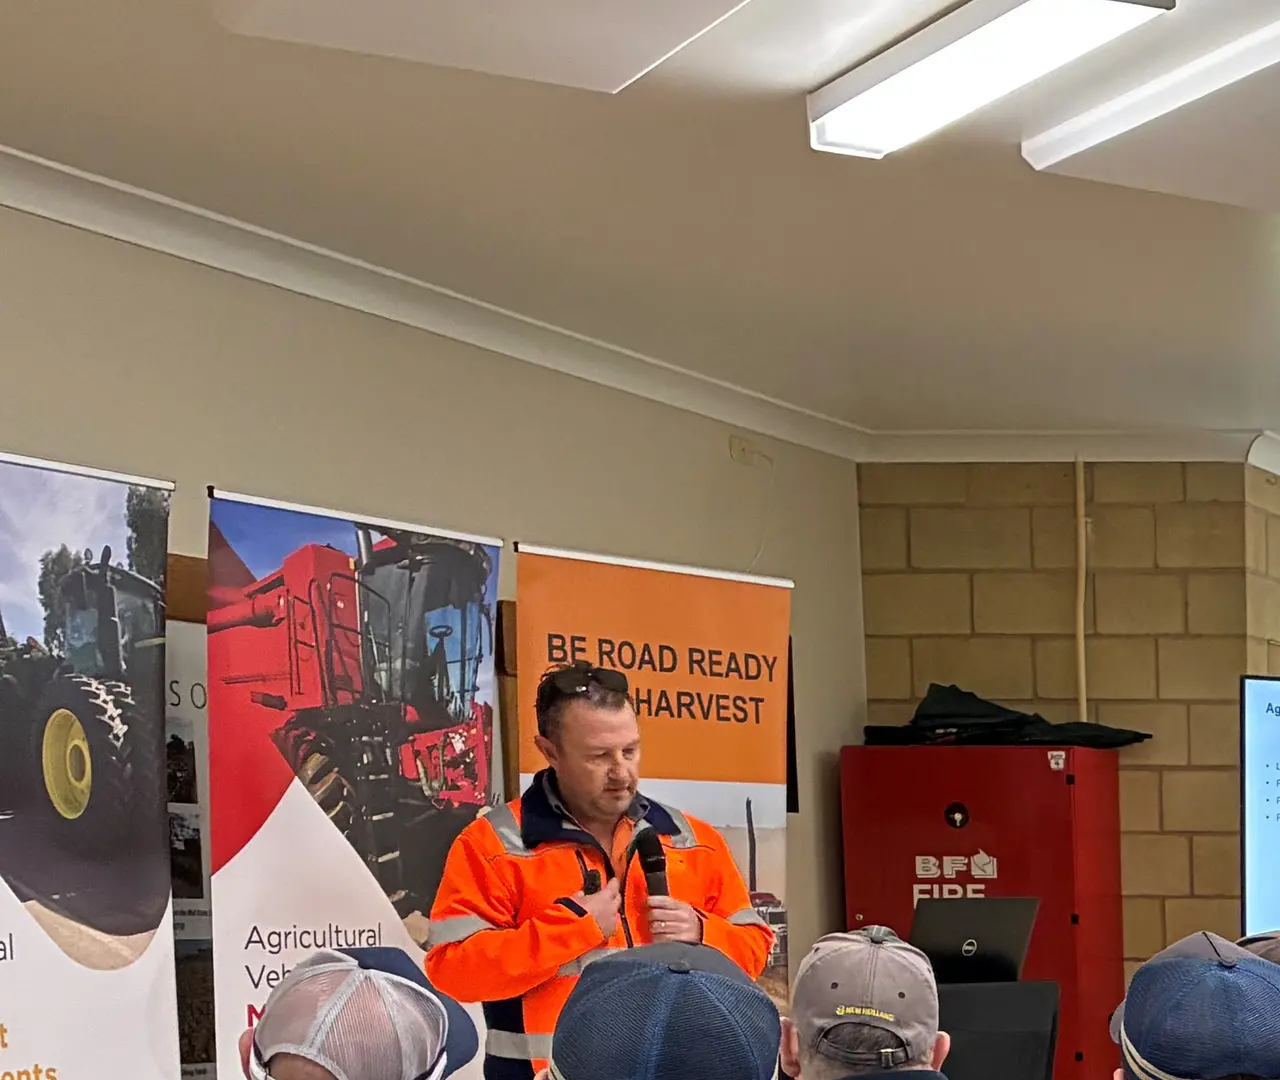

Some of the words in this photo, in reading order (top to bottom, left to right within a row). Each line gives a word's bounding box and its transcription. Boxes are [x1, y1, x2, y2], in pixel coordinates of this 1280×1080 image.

[547, 633, 587, 663] BE
[597, 638, 678, 673] ROAD
[688, 647, 778, 682] READY
[634, 688, 765, 724] HARVEST
[244, 922, 382, 954] Agricultural
